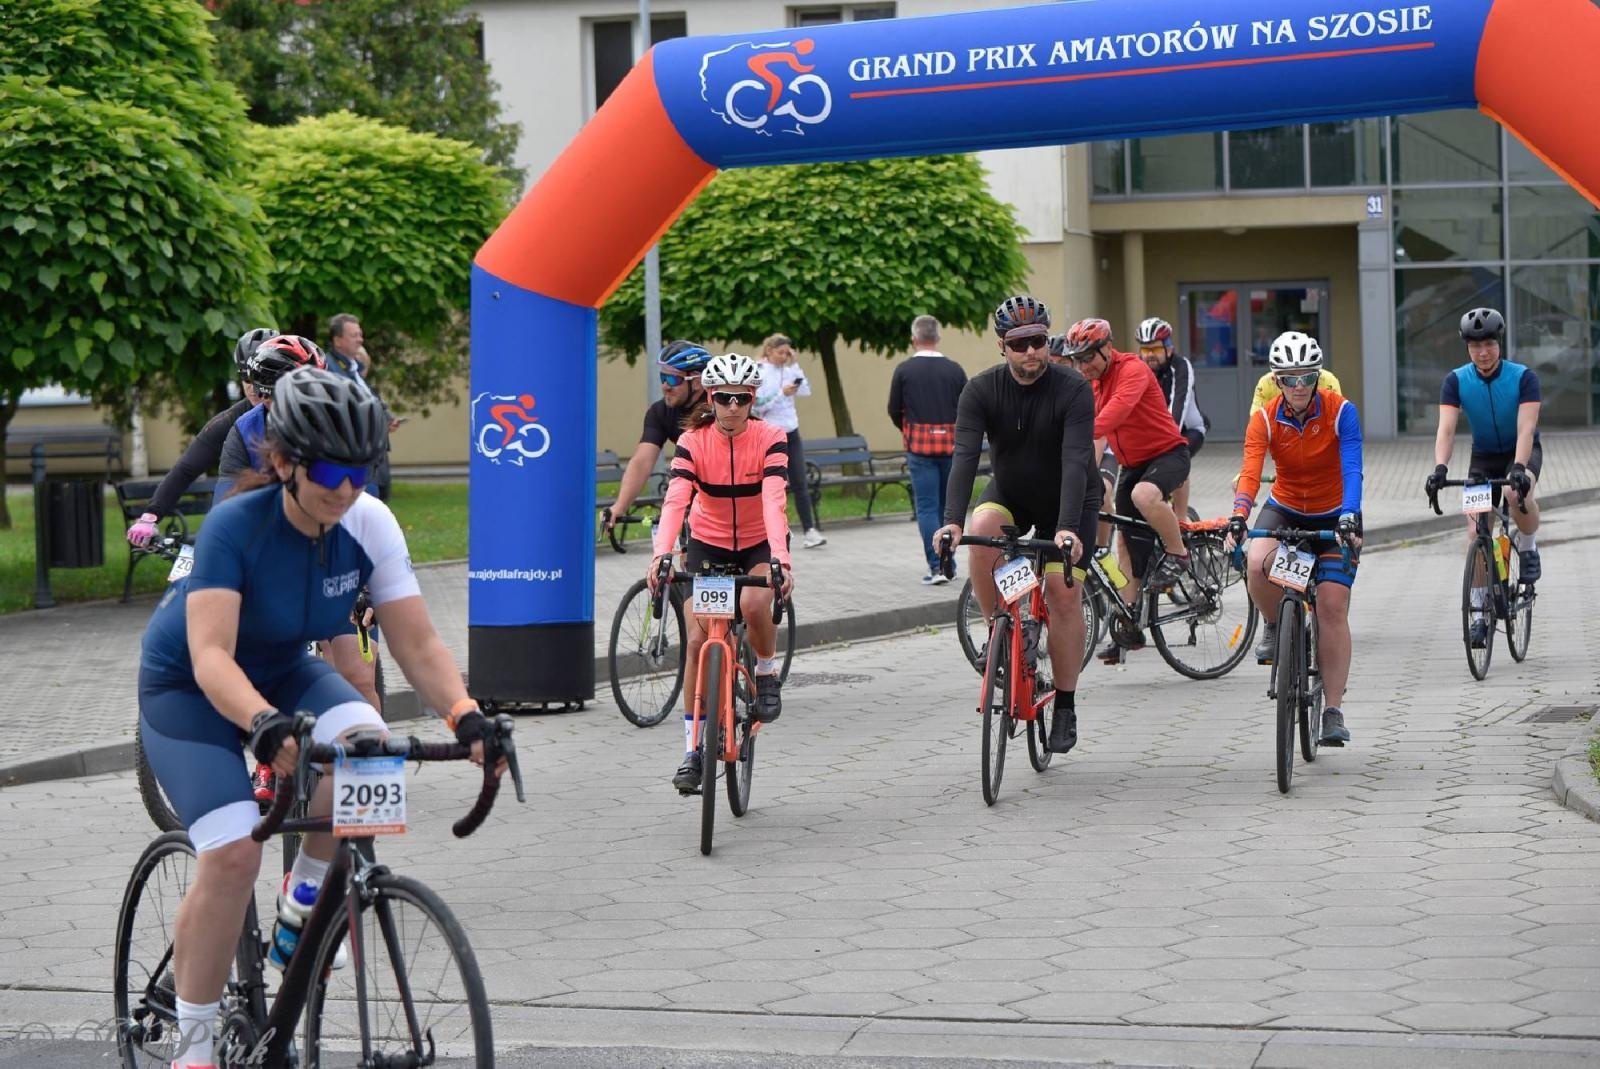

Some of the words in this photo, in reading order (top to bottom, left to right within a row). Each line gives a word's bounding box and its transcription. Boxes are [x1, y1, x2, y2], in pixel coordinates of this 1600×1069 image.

[848, 51, 956, 82] GRAND
[967, 43, 1038, 73] PRIX
[1047, 20, 1239, 66] AMATORÓW
[1251, 20, 1297, 46] NA
[1307, 4, 1434, 42] SZOSIE
[1367, 195, 1383, 213] 31
[1465, 493, 1490, 504] 2084
[1276, 556, 1310, 578] 2112
[1000, 566, 1030, 591] 2222
[701, 591, 728, 603] 099
[340, 783, 403, 807] 2093
